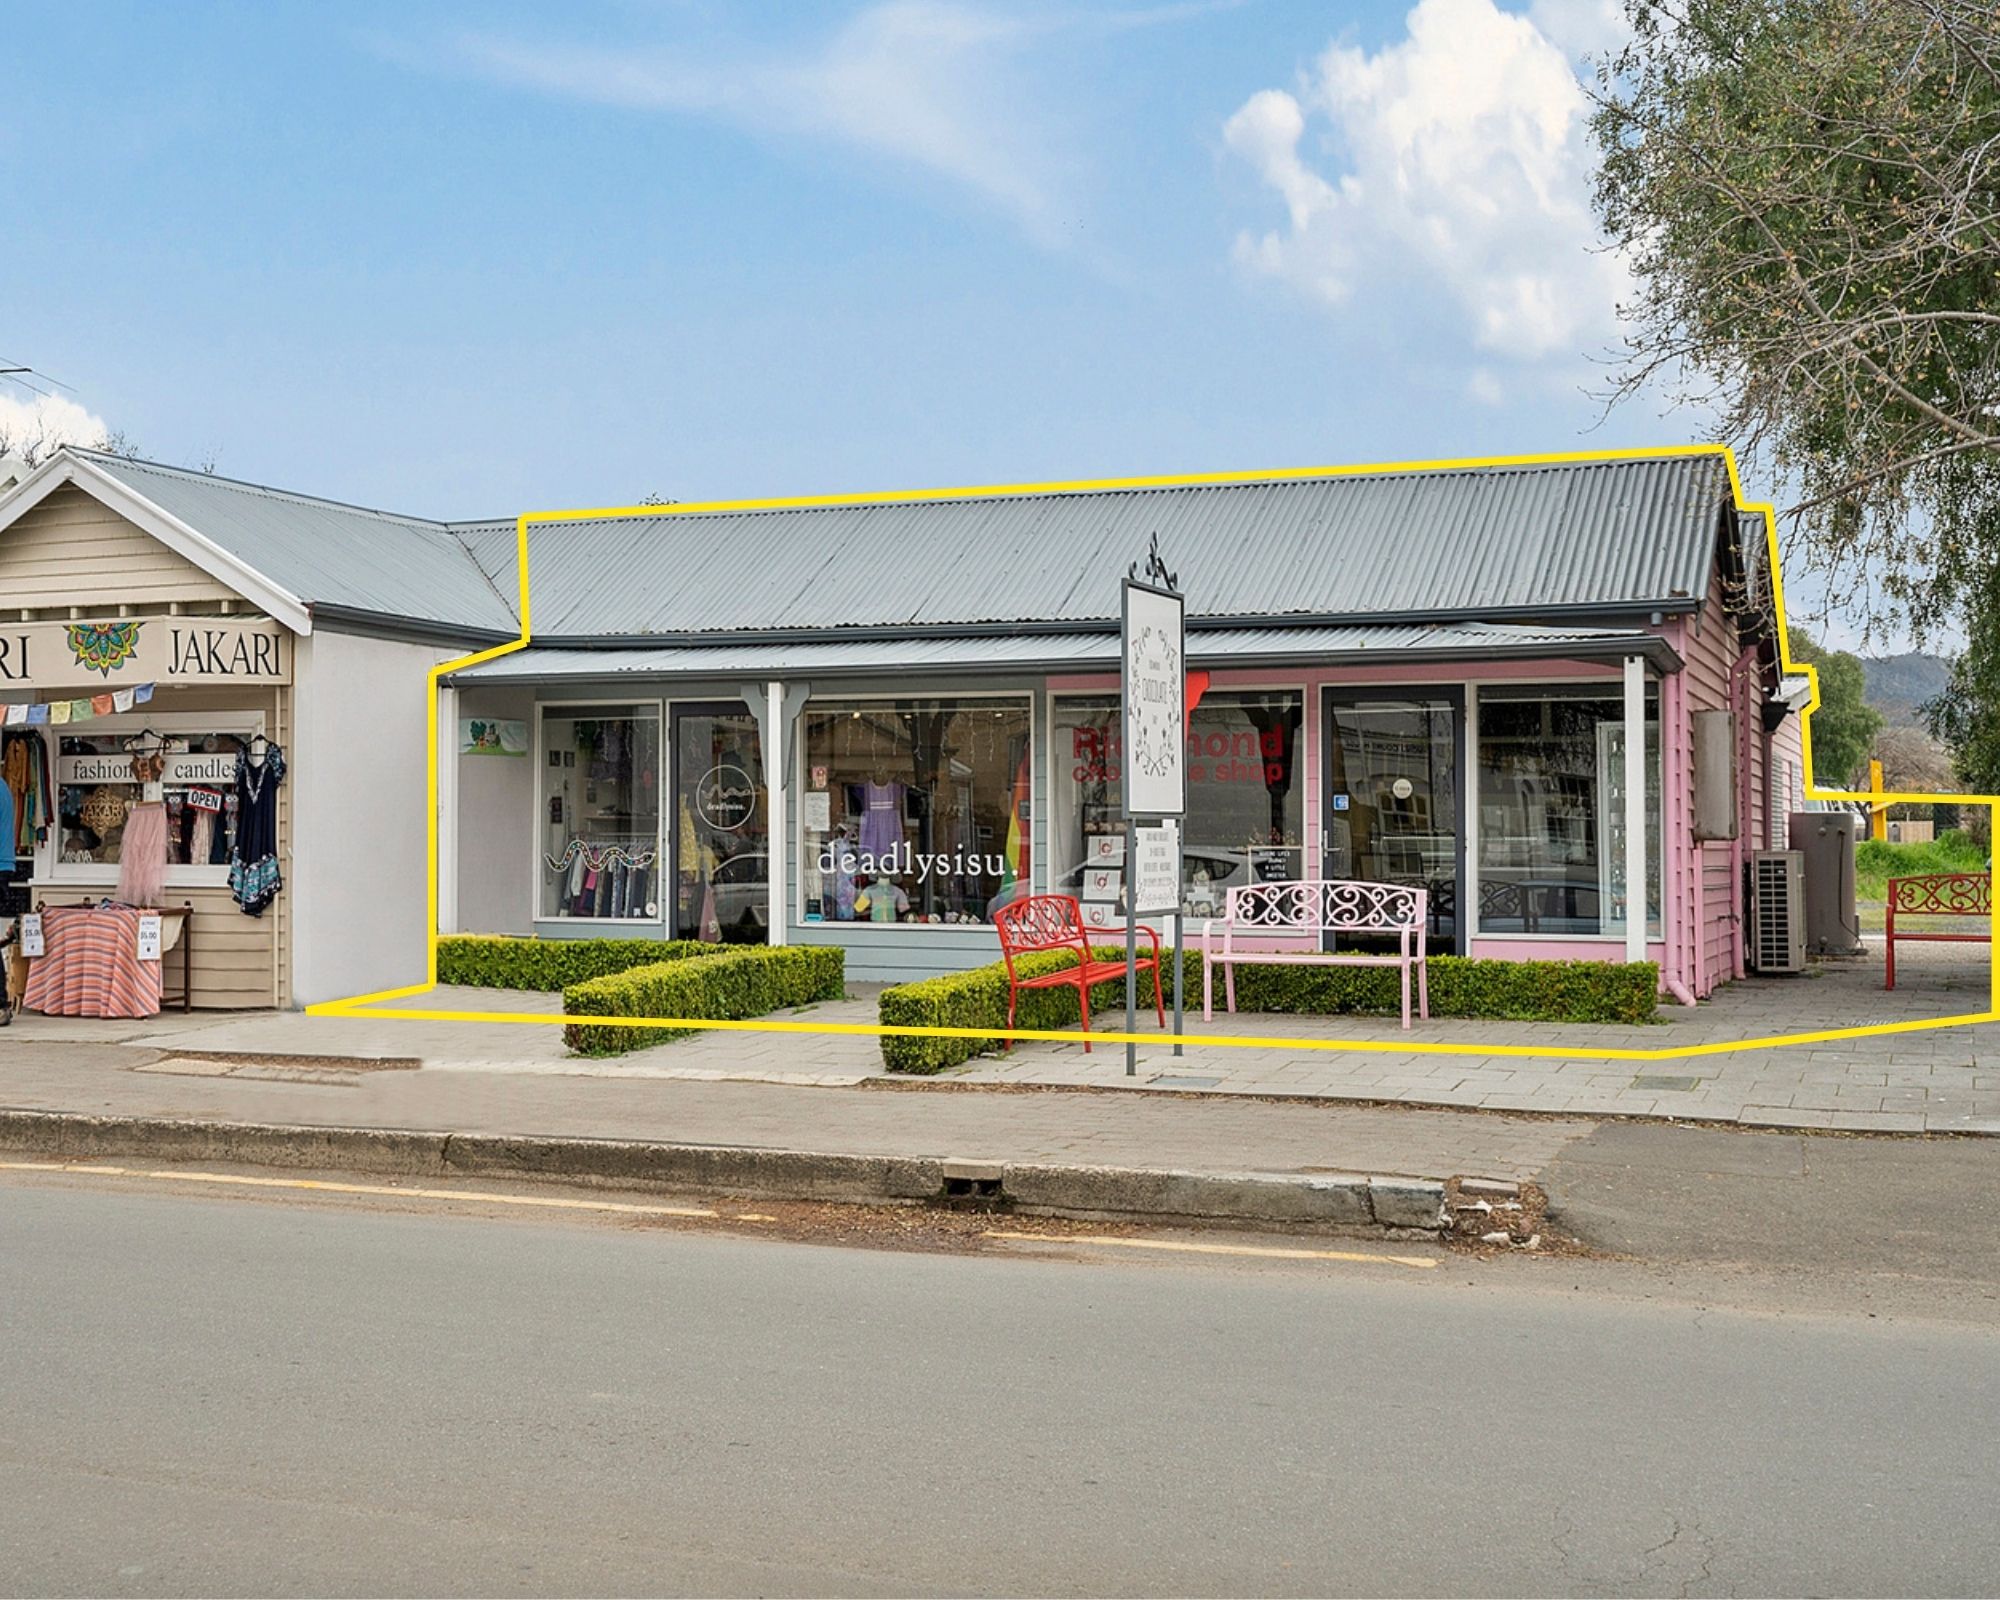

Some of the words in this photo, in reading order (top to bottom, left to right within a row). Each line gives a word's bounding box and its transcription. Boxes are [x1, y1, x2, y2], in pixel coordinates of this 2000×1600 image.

[168, 628, 283, 676] JAKARI
[73, 759, 133, 780] fashion
[1216, 758, 1283, 785] shop
[190, 790, 220, 810] OPEN
[817, 841, 1019, 885] deadlysisu.
[25, 928, 41, 938] $5.0
